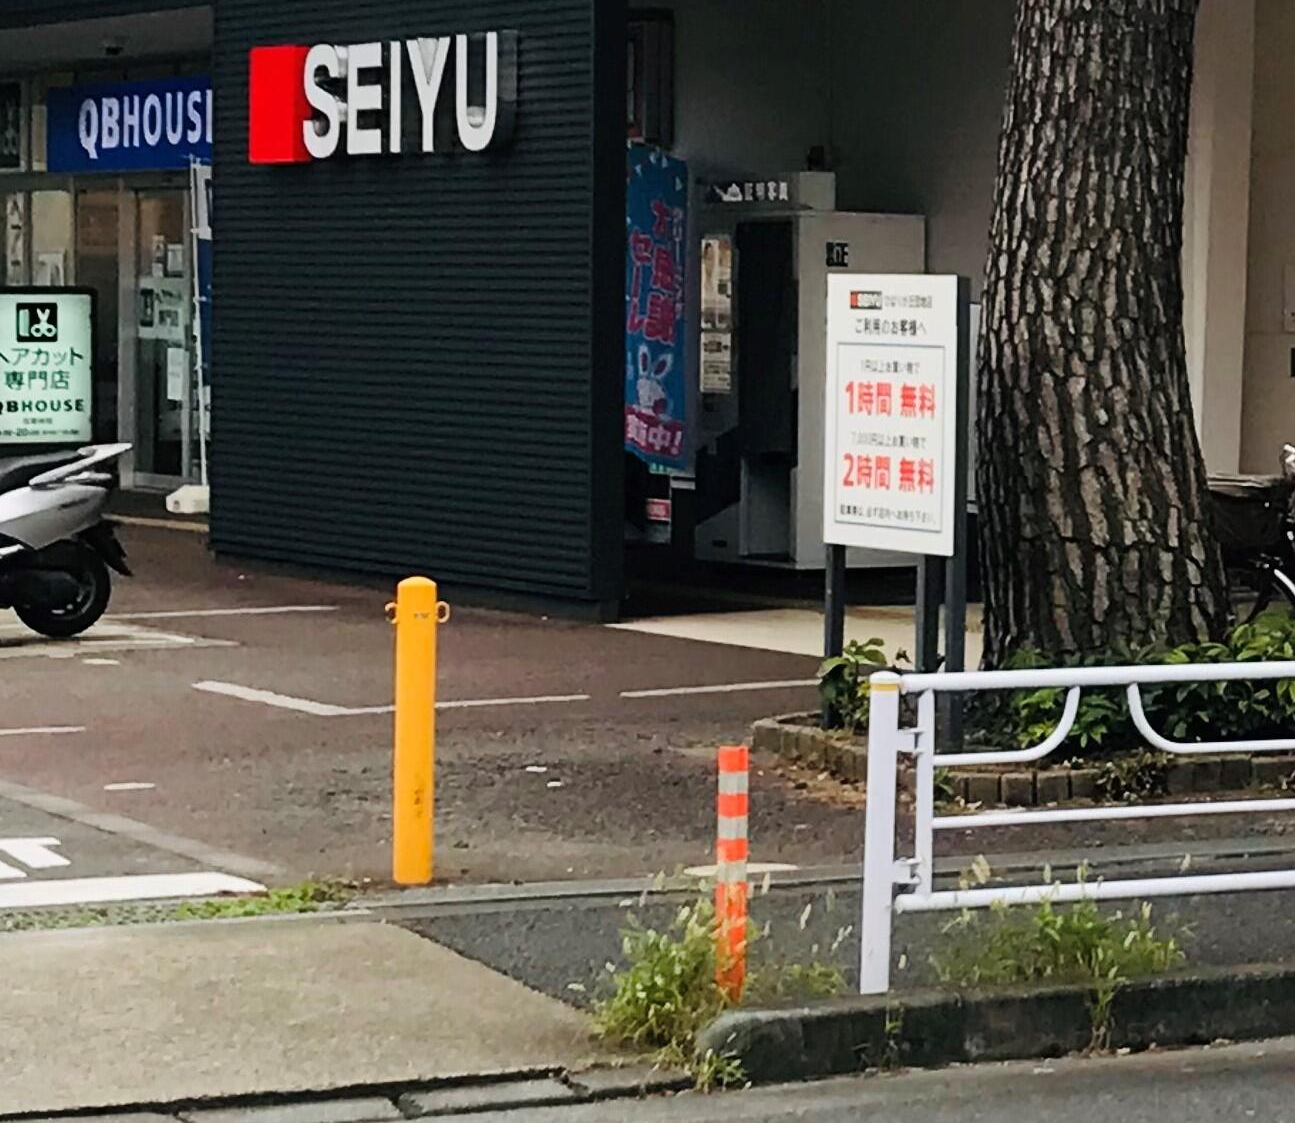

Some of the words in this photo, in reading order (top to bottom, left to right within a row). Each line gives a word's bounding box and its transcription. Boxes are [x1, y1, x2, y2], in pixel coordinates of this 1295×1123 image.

[303, 32, 499, 158] SEIYU
[5, 370, 70, 390] 専門店
[0, 399, 85, 415] BHOUSE
[845, 381, 892, 416] 1時間
[900, 382, 936, 419] 無料
[843, 453, 891, 490] 2時間
[899, 456, 934, 494] 無料
